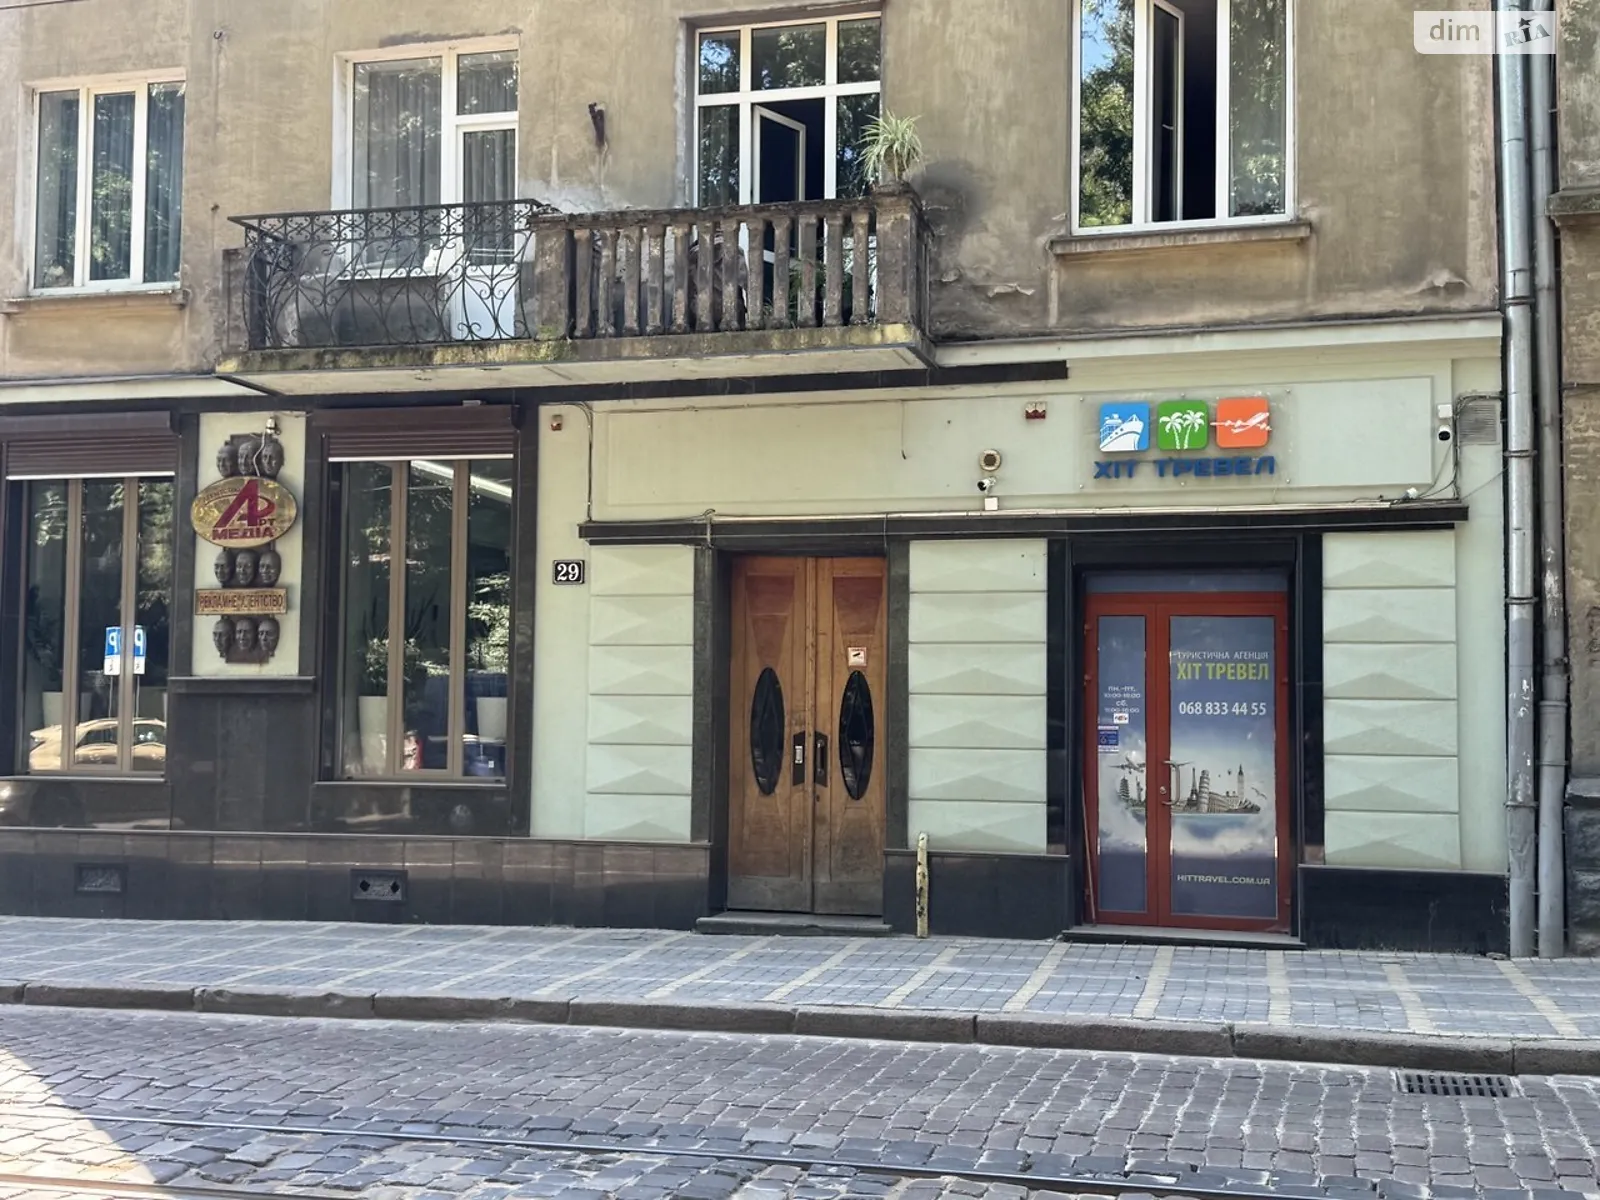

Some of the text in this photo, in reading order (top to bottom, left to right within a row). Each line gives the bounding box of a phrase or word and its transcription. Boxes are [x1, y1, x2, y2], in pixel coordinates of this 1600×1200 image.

[1093, 455, 1276, 479] ХІТ ТРЕВЕЛ
[212, 527, 274, 540] МЕДІА
[557, 563, 580, 581] 29
[1177, 662, 1269, 680] ХІТ ТРЕВЕЛ
[1178, 701, 1267, 716] 068 833 44 55
[1177, 874, 1271, 885] HITTRAVEL.COM.UA
